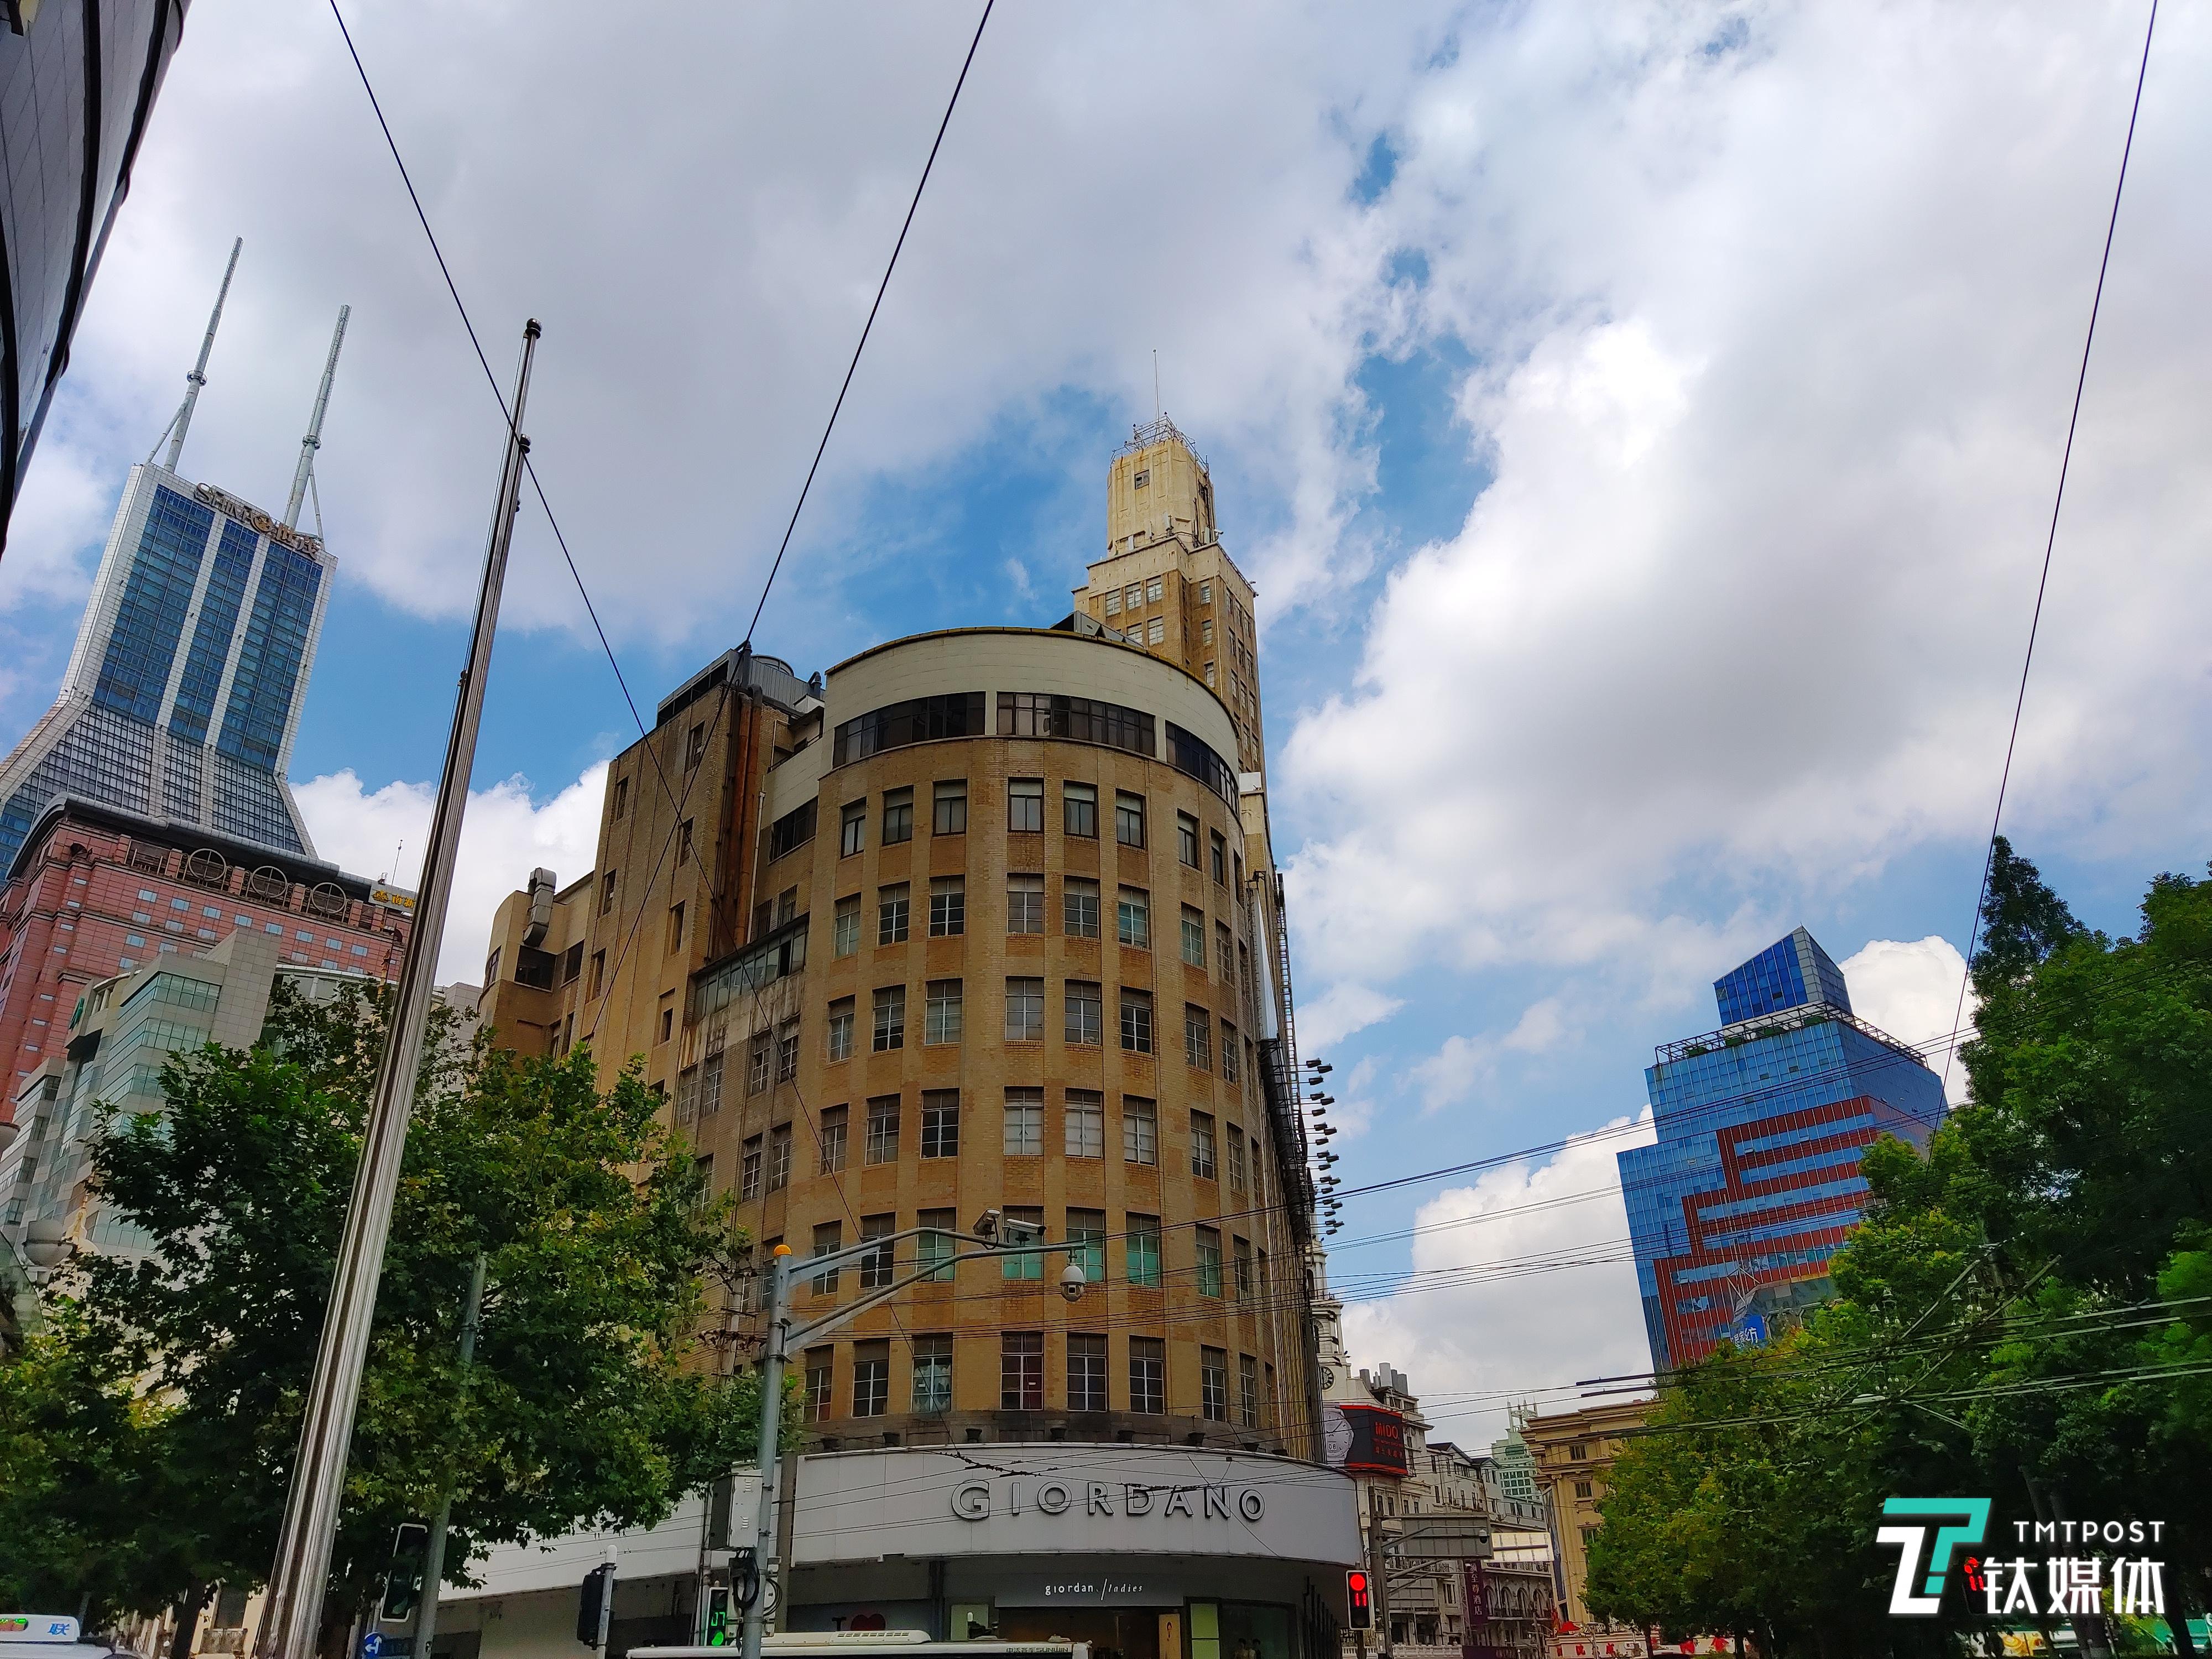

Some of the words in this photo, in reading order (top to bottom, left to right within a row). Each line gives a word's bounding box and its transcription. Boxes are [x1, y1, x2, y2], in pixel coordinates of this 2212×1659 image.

[1375, 1421, 1399, 1439] MIDO
[951, 1479, 1266, 1521] GIORDANO
[1045, 1582, 1099, 1596] giordan
